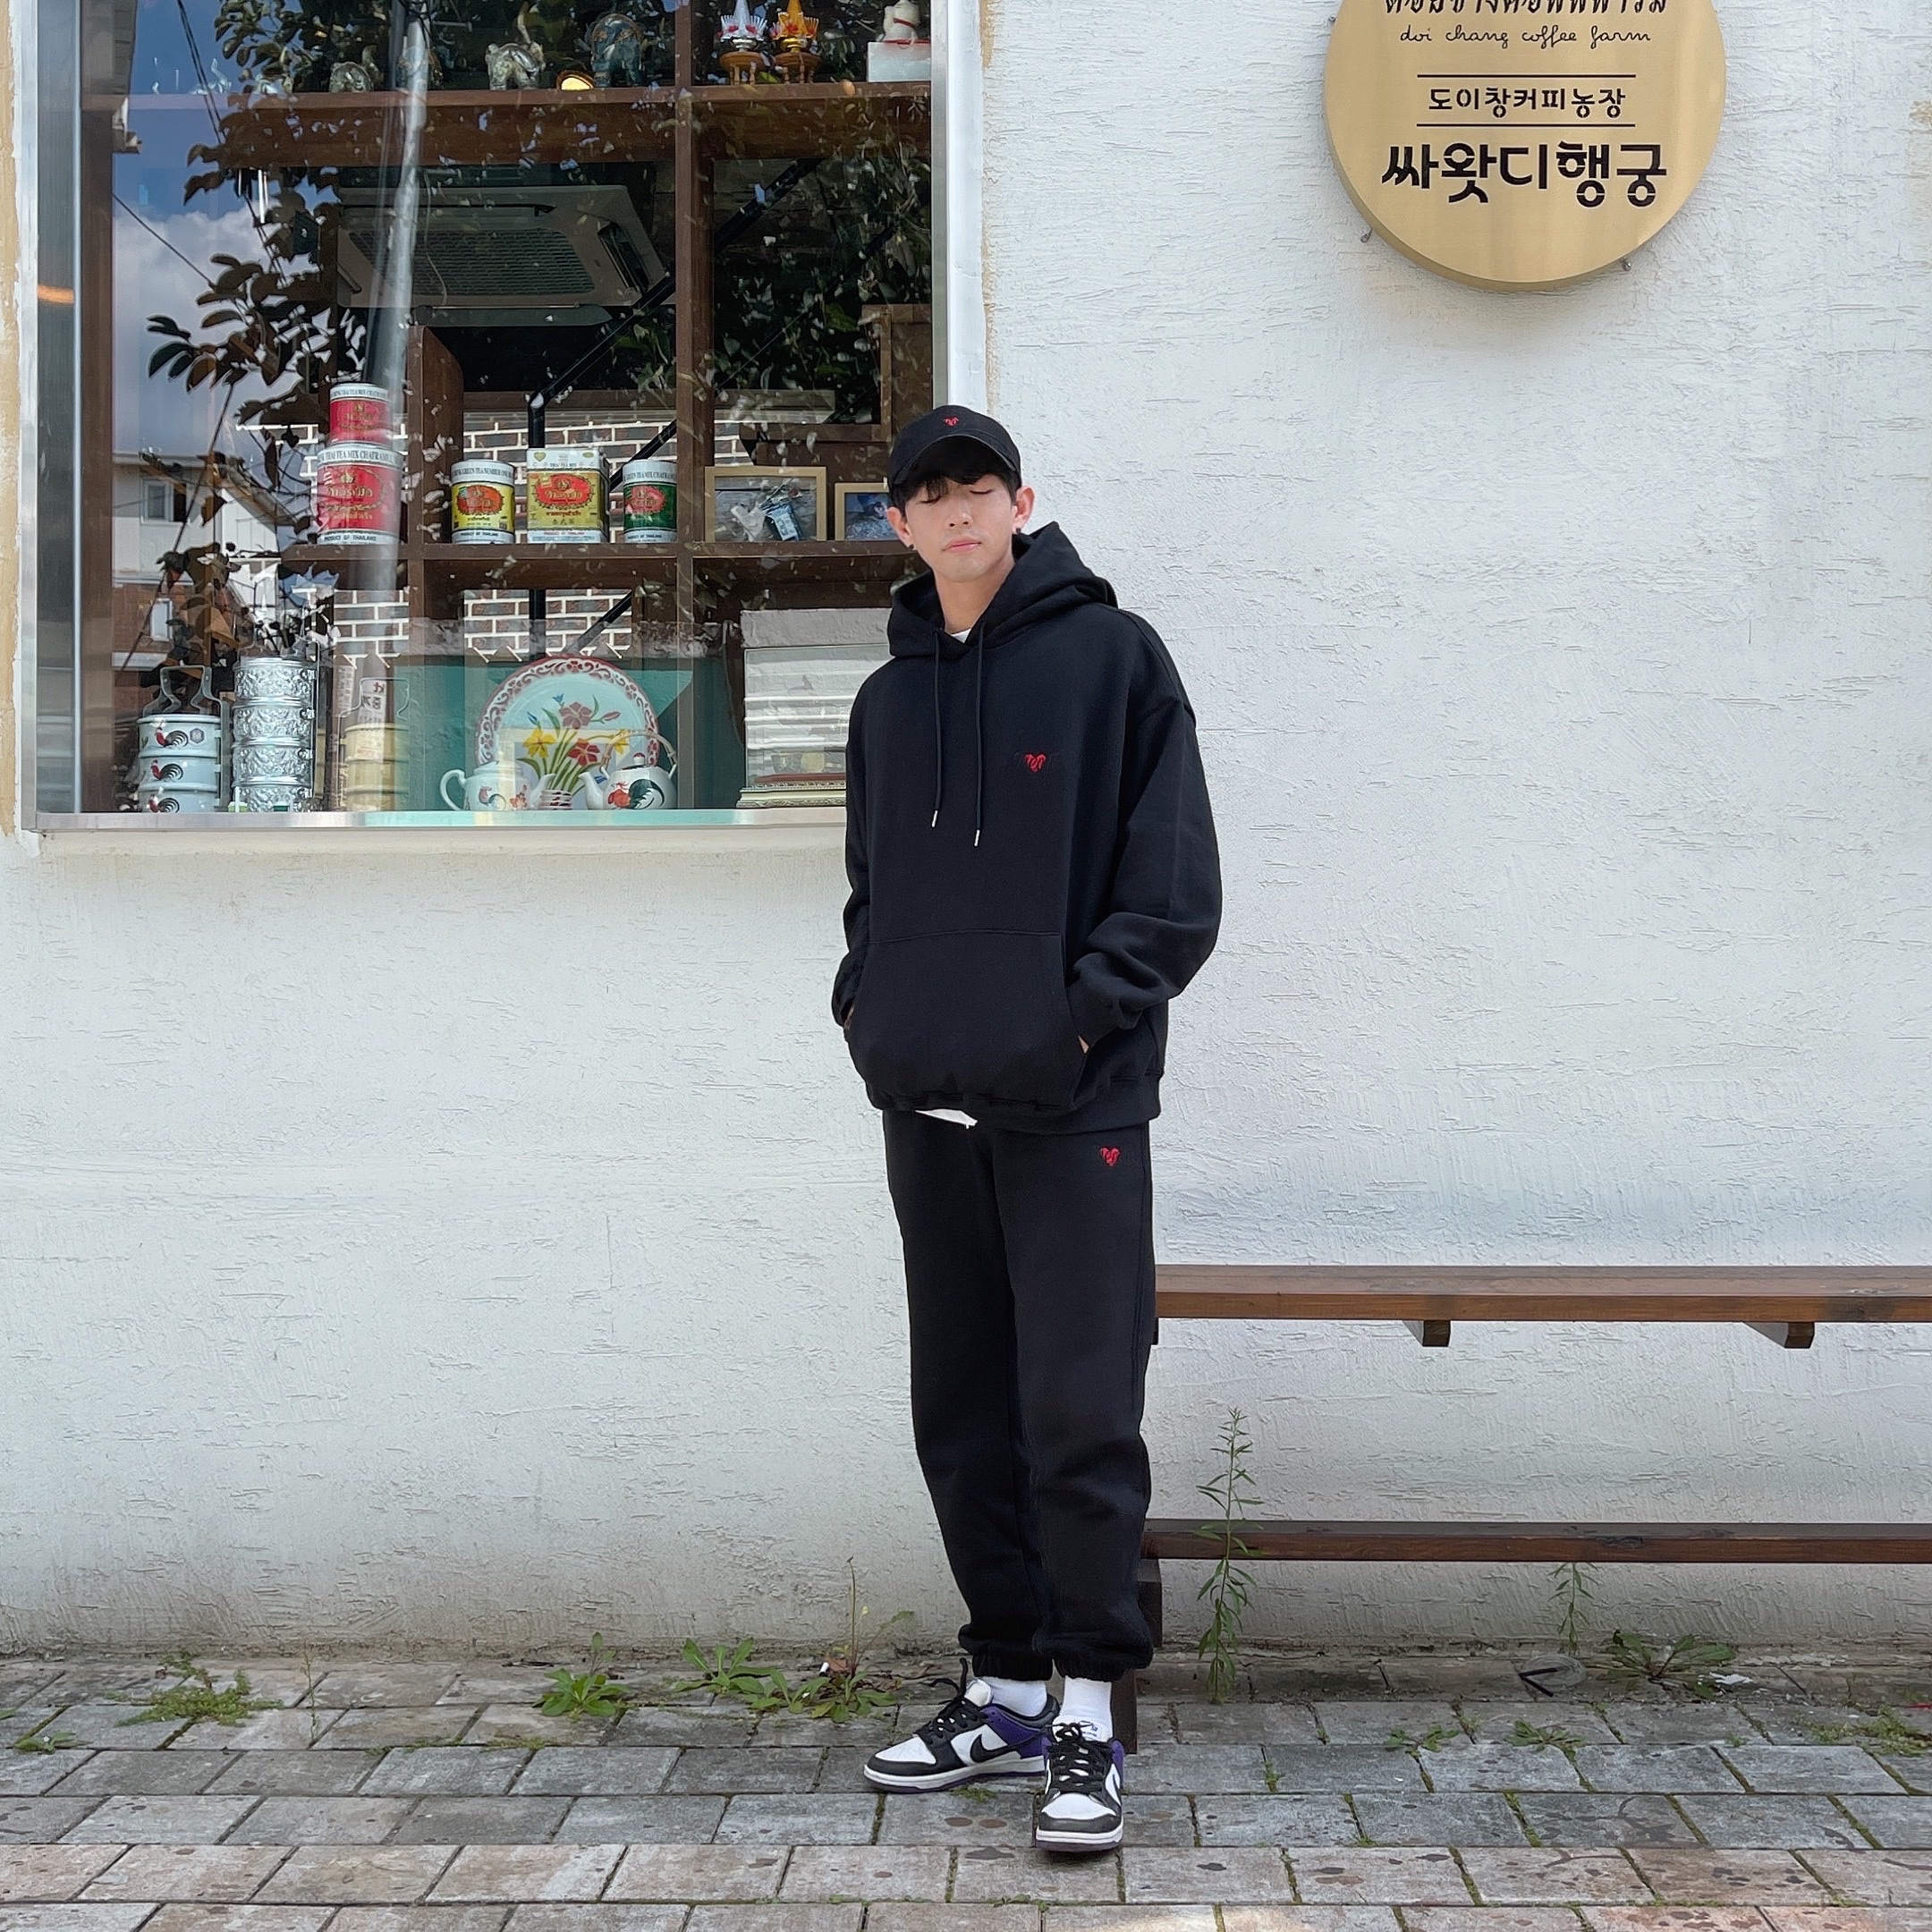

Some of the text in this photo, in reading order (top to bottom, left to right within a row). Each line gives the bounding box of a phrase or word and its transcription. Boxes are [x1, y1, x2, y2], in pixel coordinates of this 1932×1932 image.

[1400, 24, 1651, 49] doi chang coffee farm
[1428, 87, 1626, 119] 도이창커피농장
[1381, 140, 1667, 208] 싸왓디행궁
